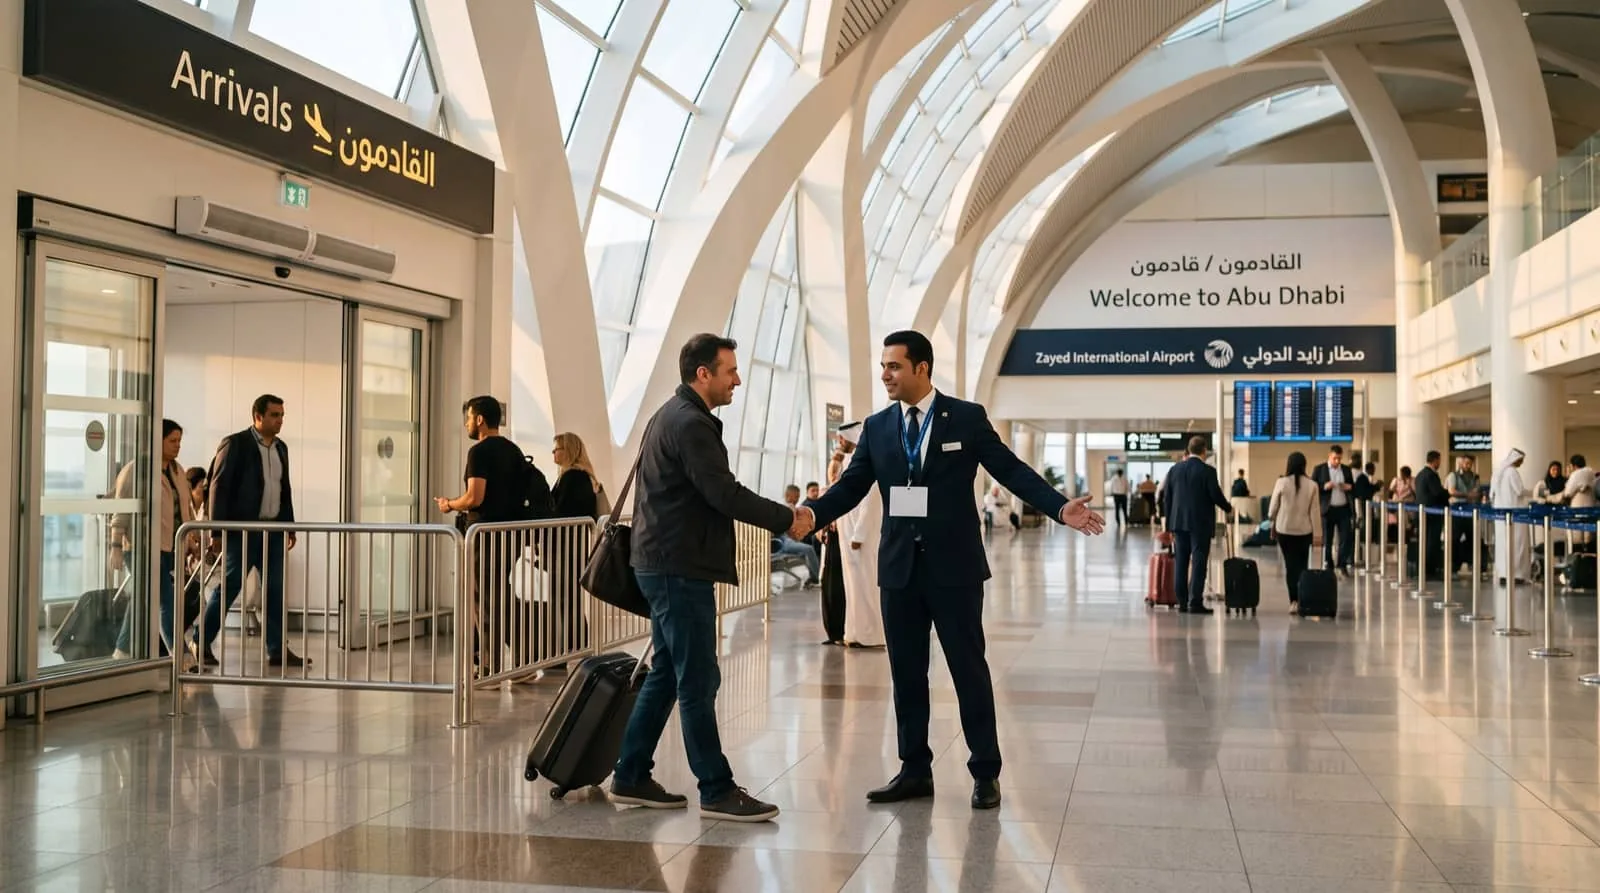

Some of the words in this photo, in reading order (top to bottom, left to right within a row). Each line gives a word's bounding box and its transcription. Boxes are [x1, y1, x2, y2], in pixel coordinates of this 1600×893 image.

[171, 50, 293, 132] Arrivals
[339, 127, 435, 187] القادمون
[1130, 255, 1200, 277] قادمون
[1204, 254, 1214, 272] /
[1218, 252, 1301, 275] القادمون
[1089, 288, 1191, 308] Welcome
[1197, 287, 1220, 306] to
[1226, 287, 1271, 306] Abu
[1279, 284, 1345, 305] Dhabi
[1035, 352, 1071, 367] Zayed
[1073, 351, 1150, 364] International
[1152, 351, 1195, 366] Airport
[1242, 345, 1293, 369] الدولي
[1296, 345, 1323, 365] زايد
[1327, 345, 1365, 365] مطار
